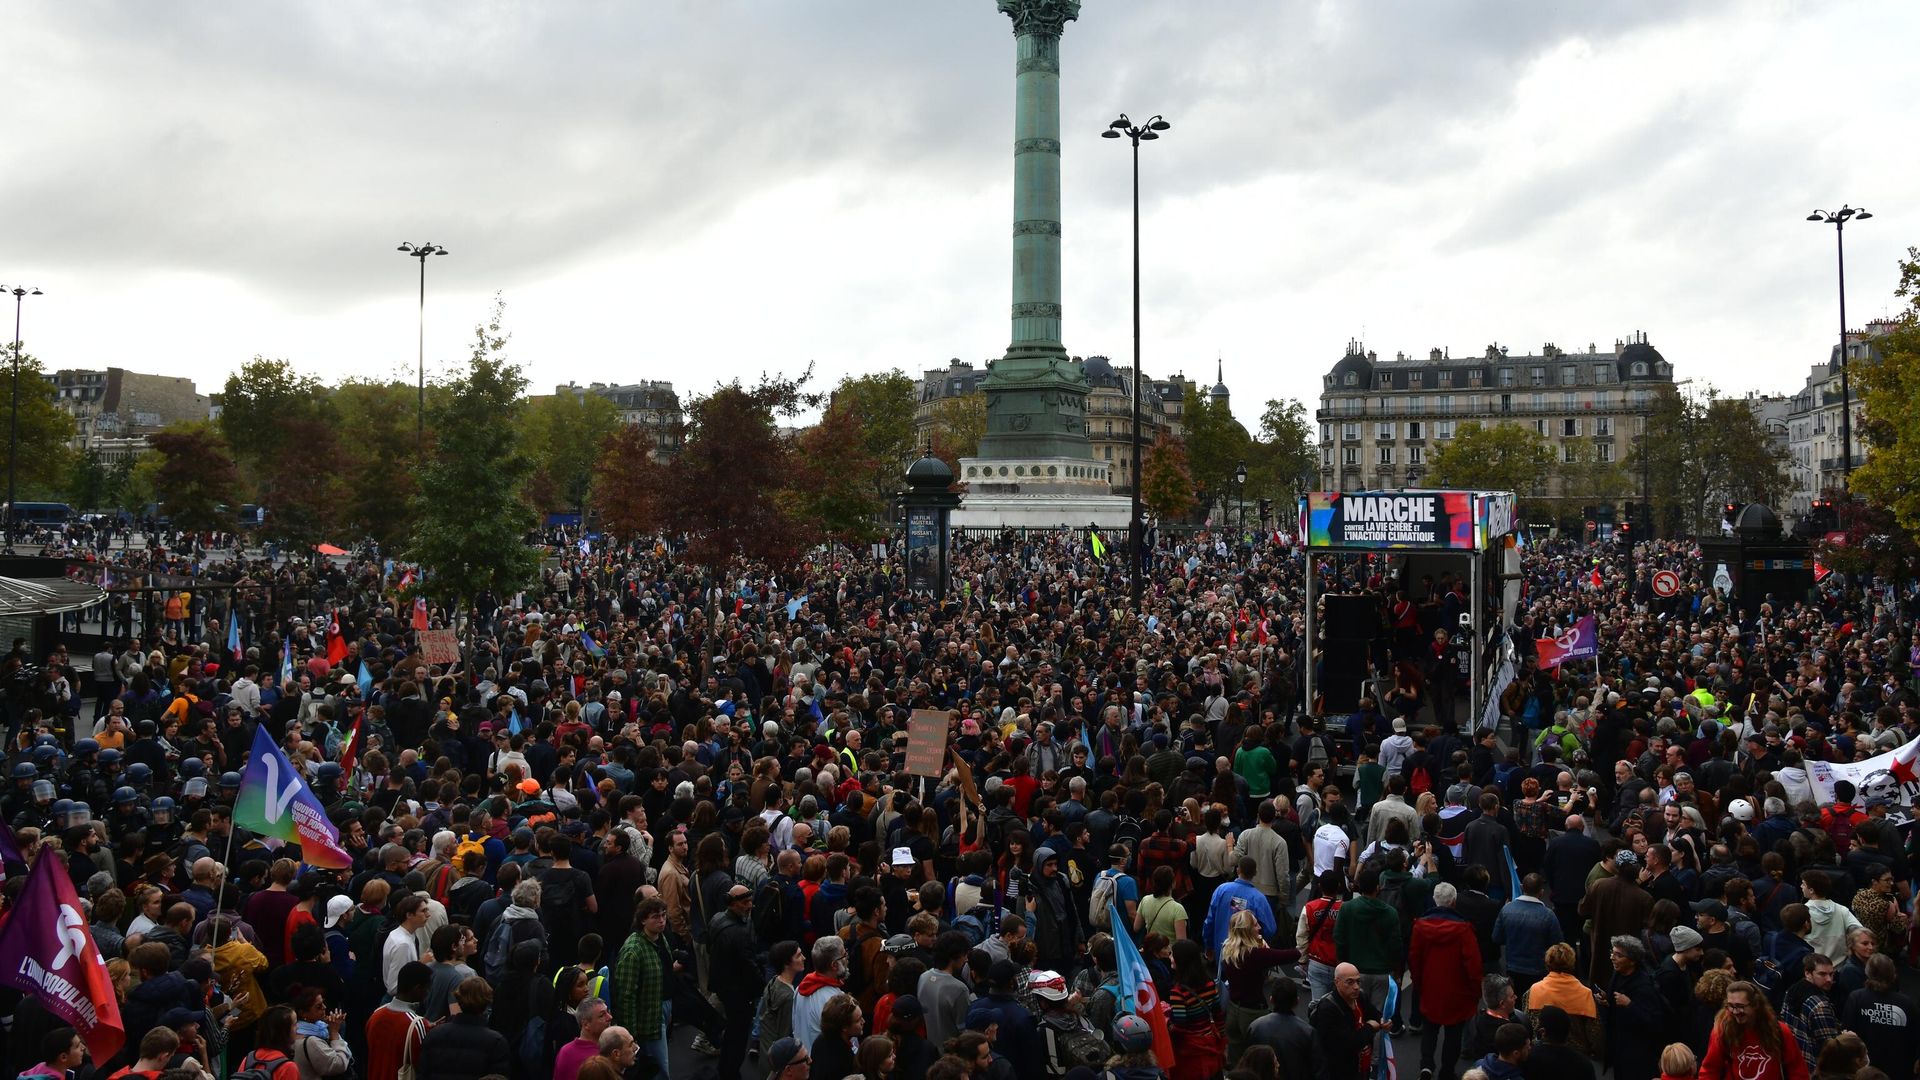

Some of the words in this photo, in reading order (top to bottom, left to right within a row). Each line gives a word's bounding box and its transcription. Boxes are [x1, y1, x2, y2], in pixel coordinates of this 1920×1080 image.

[1343, 497, 1435, 522] MARCHE
[1365, 522, 1375, 531] LA
[1375, 522, 1388, 531] VIE
[1388, 520, 1412, 531] CHÈRE
[1344, 531, 1387, 541] L'INACTION
[1388, 531, 1435, 542] CLIMATIQUE
[426, 652, 457, 662] GRAND
[292, 800, 322, 822] NOUVELLE
[295, 820, 322, 842] OGIQUE
[42, 971, 98, 1029] POPULAIRE
[1874, 1002, 1892, 1011] THE
[1861, 1008, 1892, 1018] NORTH
[1870, 1016, 1893, 1025] FACE
